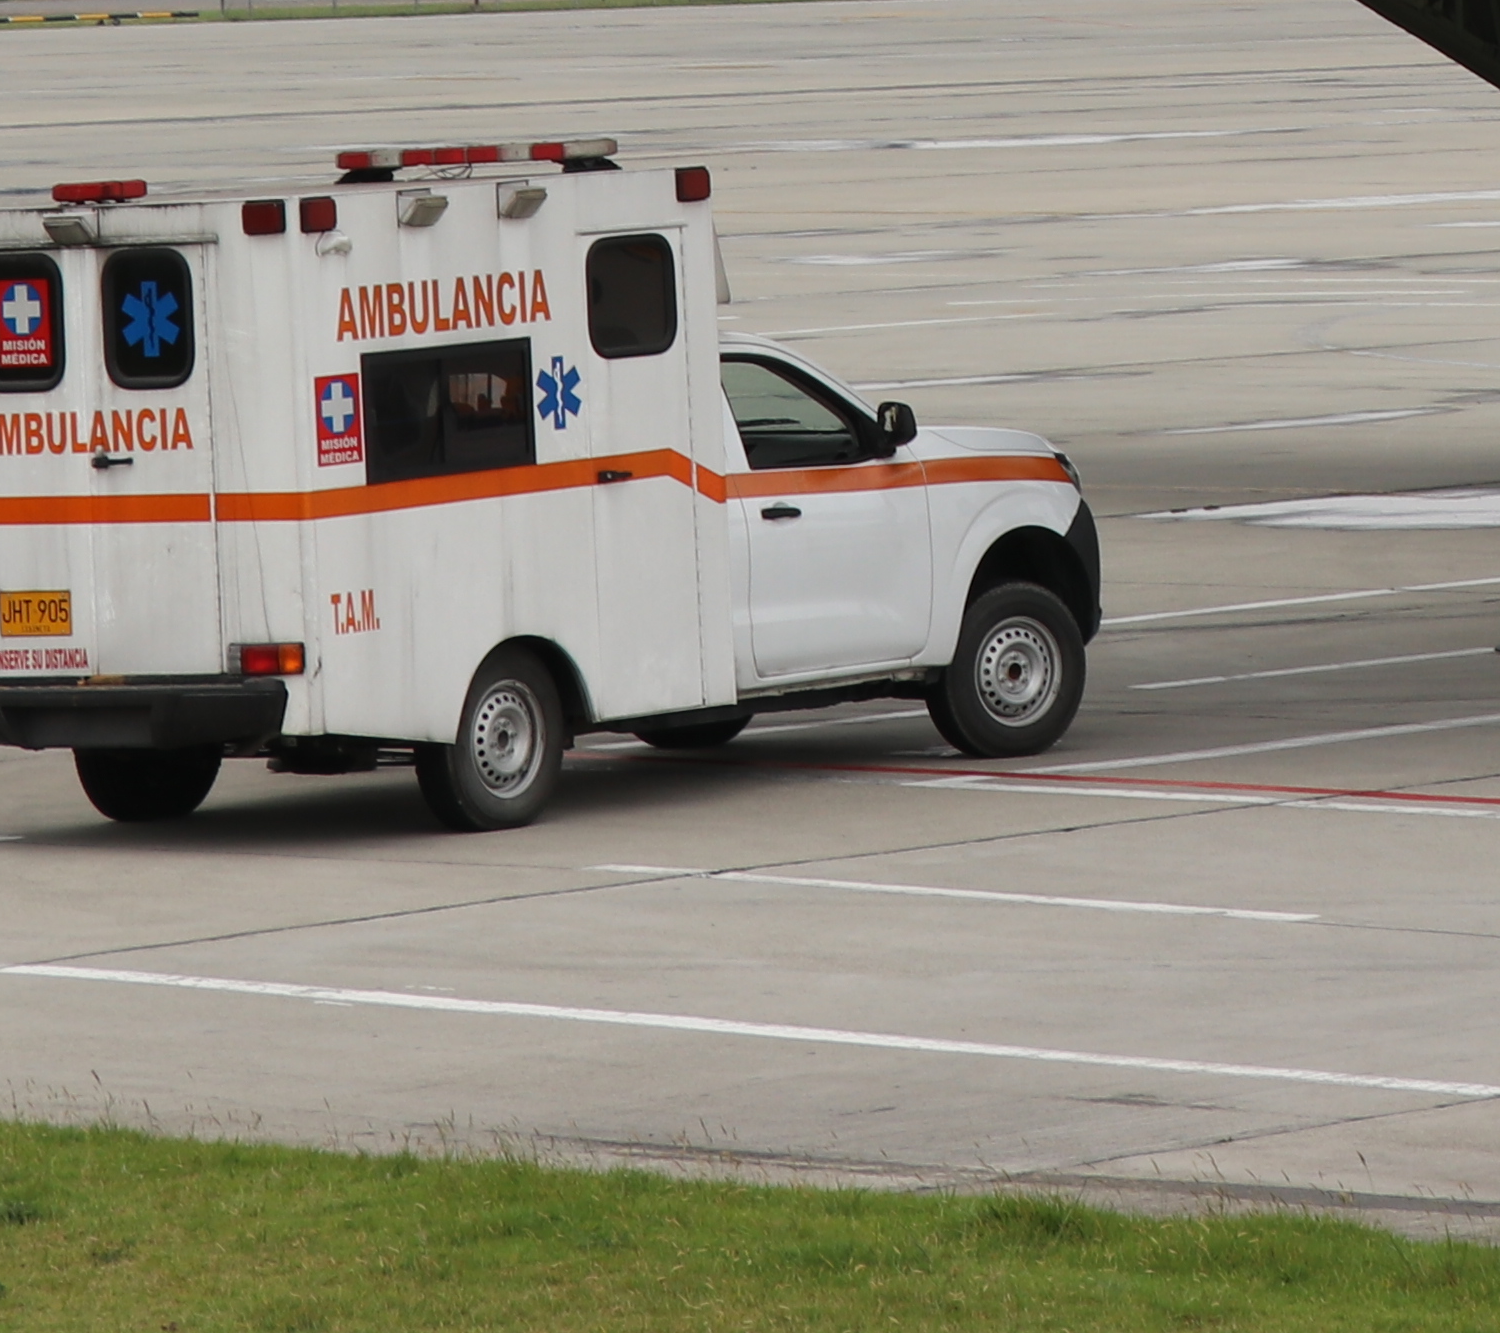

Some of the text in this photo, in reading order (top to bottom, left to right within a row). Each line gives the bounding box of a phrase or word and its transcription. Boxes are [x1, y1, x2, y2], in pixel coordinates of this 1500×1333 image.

[337, 269, 552, 342] AMBULANCIA
[2, 337, 46, 351] MISIÓN
[1, 352, 48, 365] MÉDICA
[321, 435, 358, 451] MISIÓN
[320, 450, 360, 464] MÉDICA
[2, 597, 69, 623] JHT 905
[331, 589, 380, 635] T.A.M.
[32, 649, 44, 670] SU
[45, 648, 89, 670] DISTANCIA
